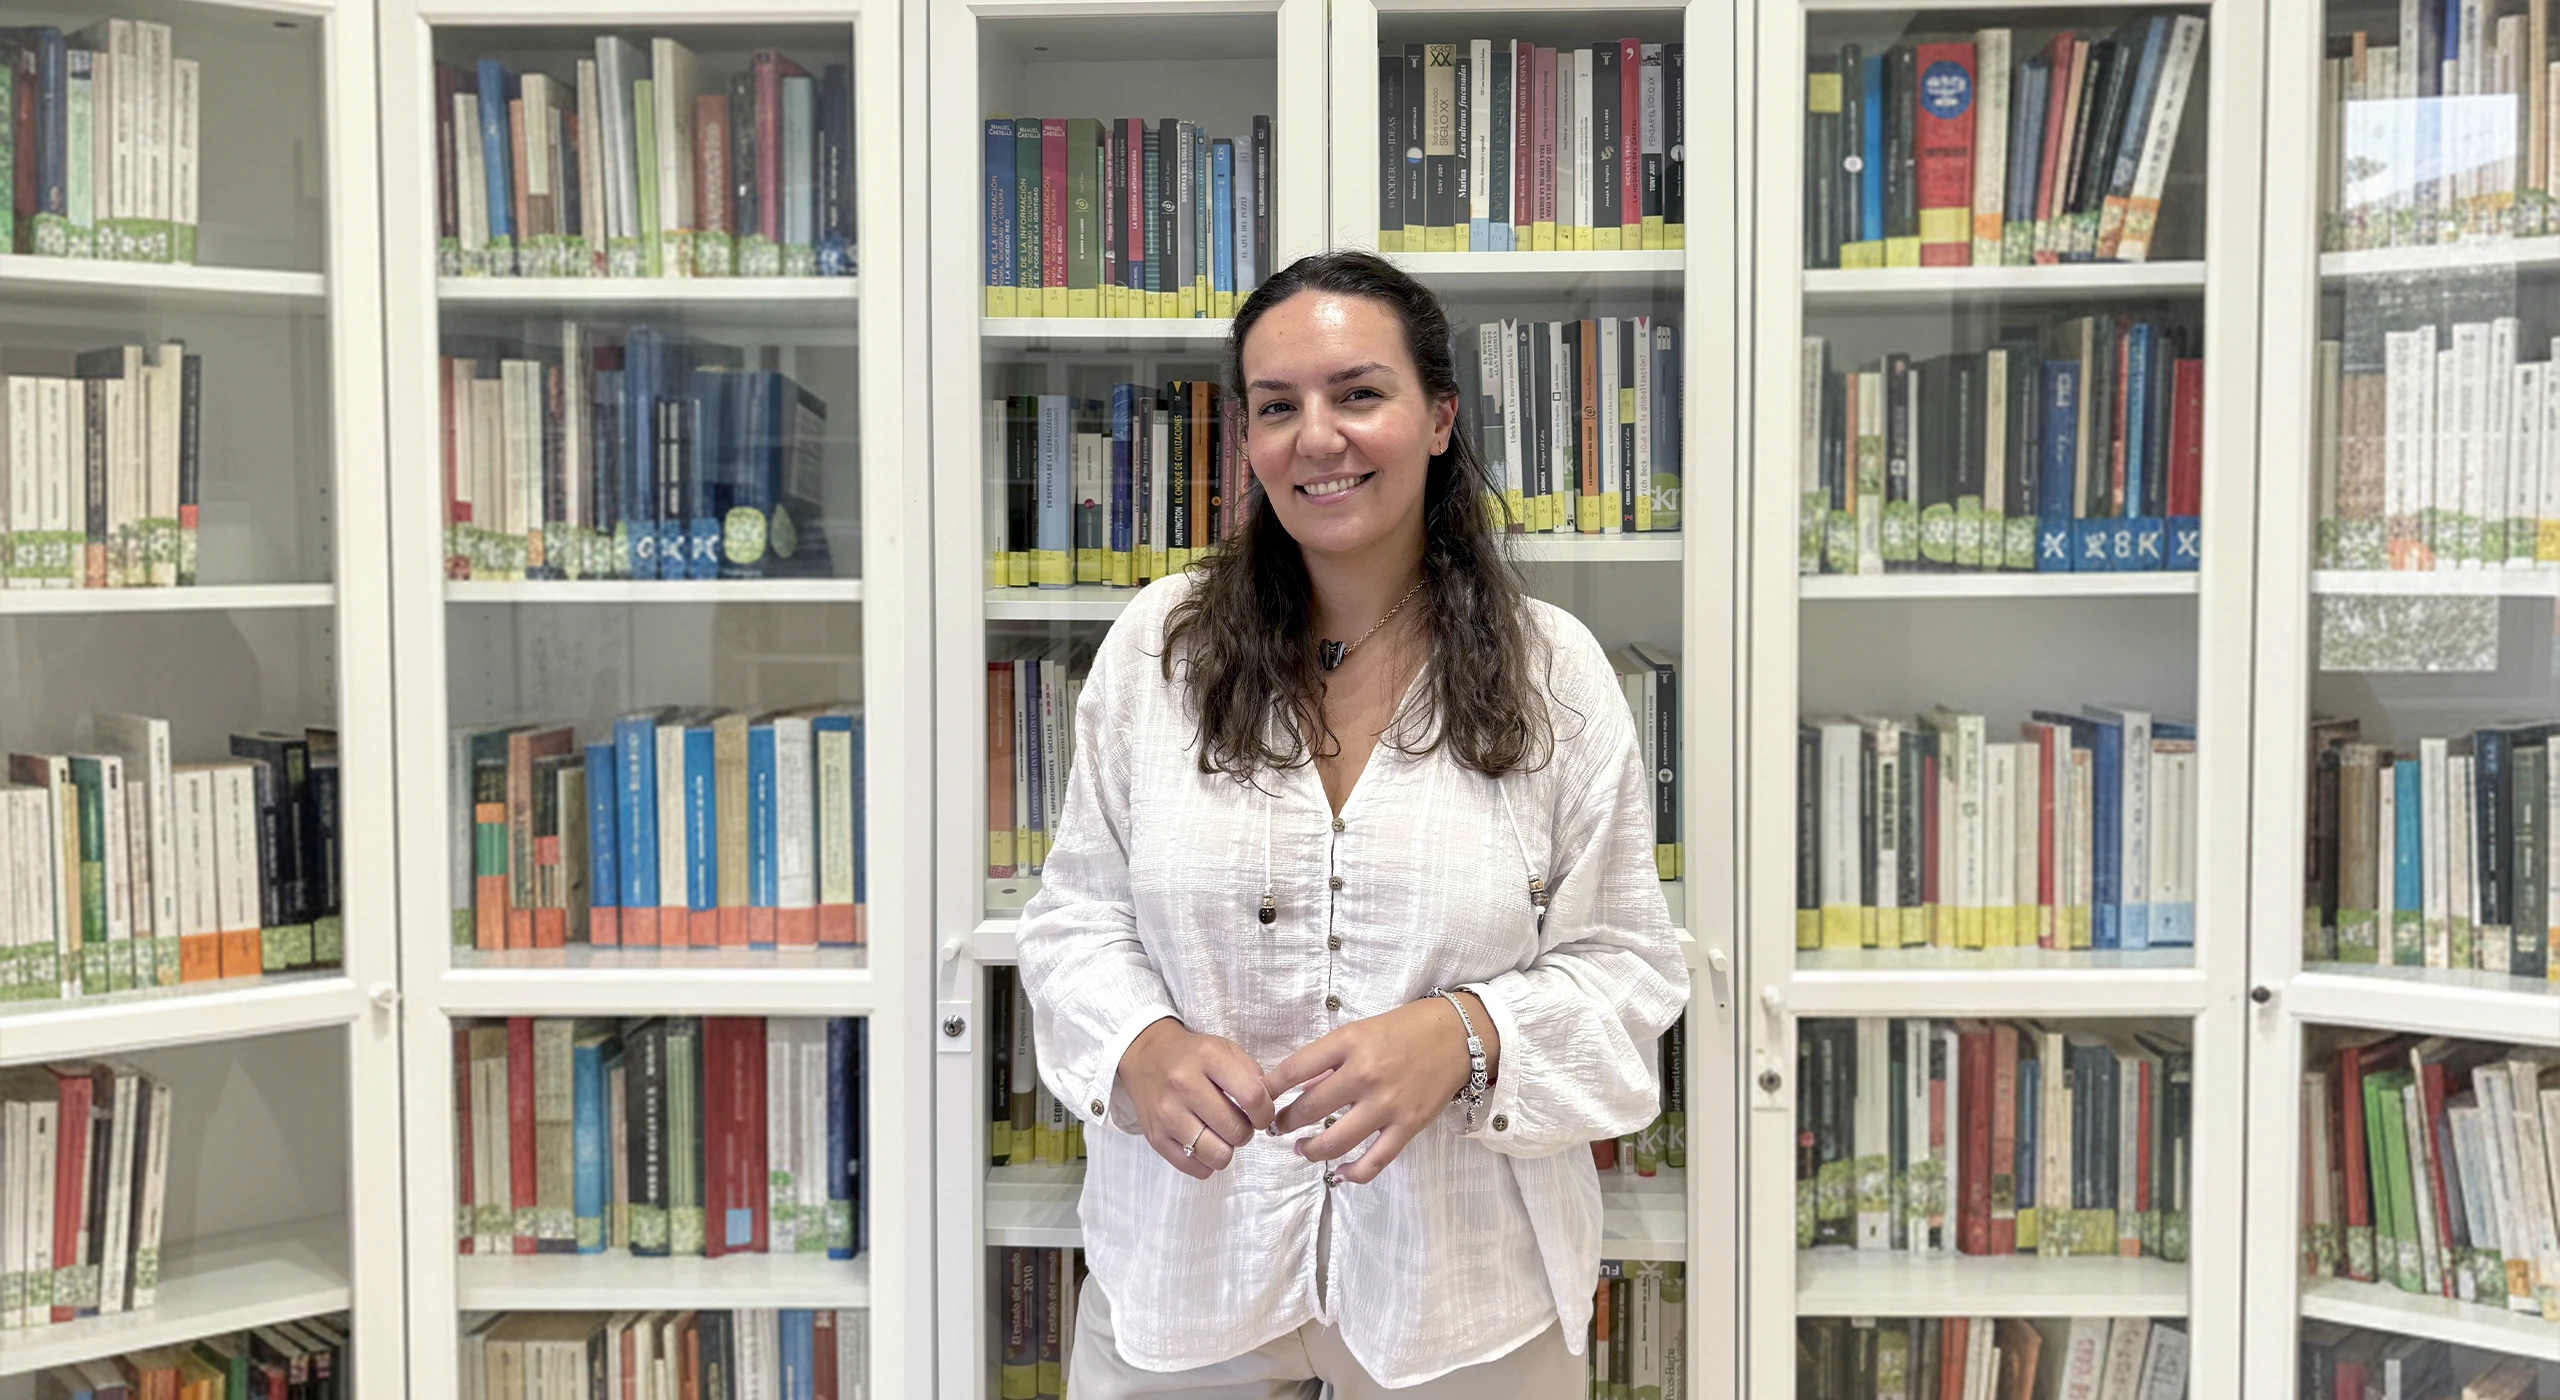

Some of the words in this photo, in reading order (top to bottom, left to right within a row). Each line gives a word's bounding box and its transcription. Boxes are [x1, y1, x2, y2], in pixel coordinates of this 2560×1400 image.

[1430, 52, 1451, 67] XX
[1458, 64, 1468, 108] fracasadas
[1519, 85, 1527, 110] SOBRE
[1440, 99, 1449, 113] XX
[1388, 117, 1396, 145] IDEAS
[1440, 115, 1449, 146] SIGLO
[1458, 109, 1467, 141] culturas
[1519, 112, 1527, 146] INFORME
[1458, 143, 1467, 158] Las
[1389, 157, 1395, 165] DE
[1388, 166, 1396, 199] PODER
[1458, 169, 1467, 198] Marina
[1546, 184, 1552, 192] DE
[1539, 187, 1545, 195] LA
[989, 175, 998, 236] INFORMACIÓN
[1019, 178, 1027, 238] INFORMACIÓN
[1043, 176, 1051, 237] INFORMACIÓN
[1389, 200, 1395, 208] EL
[1034, 224, 1039, 233] LA
[991, 239, 998, 250] LA
[1034, 234, 1039, 244] DE
[1020, 242, 1027, 253] LA
[1044, 240, 1051, 251] LA
[991, 253, 998, 265] DE
[1044, 254, 1051, 266] DE
[1057, 255, 1063, 264] DE
[1242, 251, 1248, 259] EL
[1020, 256, 1027, 268] DE
[1005, 270, 1011, 280] LA
[1034, 271, 1039, 280] EL
[1482, 357, 1487, 365] EL
[1639, 355, 1648, 411] globalización?
[1508, 399, 1515, 407] Un
[1639, 413, 1647, 421] la
[1641, 425, 1647, 434] es
[1174, 415, 1183, 461] CIVILIZACIONES
[1639, 436, 1648, 454] ¿Qué
[1047, 454, 1053, 462] LA
[1047, 463, 1053, 472] DE
[1174, 462, 1183, 470] DE
[1640, 460, 1648, 477] Beck
[1175, 471, 1184, 496] CHOQUE
[1047, 500, 1053, 508] EN
[1175, 507, 1184, 546] HUNTINGTON
[1648, 712, 1653, 720] DE
[1648, 742, 1653, 750] DE
[1648, 771, 1653, 779] UN
[1048, 759, 1057, 814] EMPRENDEDORES
[1051, 819, 1057, 828] DE
[1671, 1046, 1679, 1054] La
[1670, 1058, 1681, 1074] Lévy
[1671, 1075, 1680, 1112] ard-Henri
[1011, 1253, 1021, 1285] mundo
[1047, 1251, 1057, 1283] mundo
[1024, 1265, 1034, 1291] 2010
[1011, 1287, 1021, 1301] del
[1047, 1285, 1057, 1300] del
[1011, 1303, 1021, 1334] estado
[1047, 1301, 1057, 1332] estado
[1011, 1336, 1021, 1345] El
[1047, 1334, 1057, 1343] El
